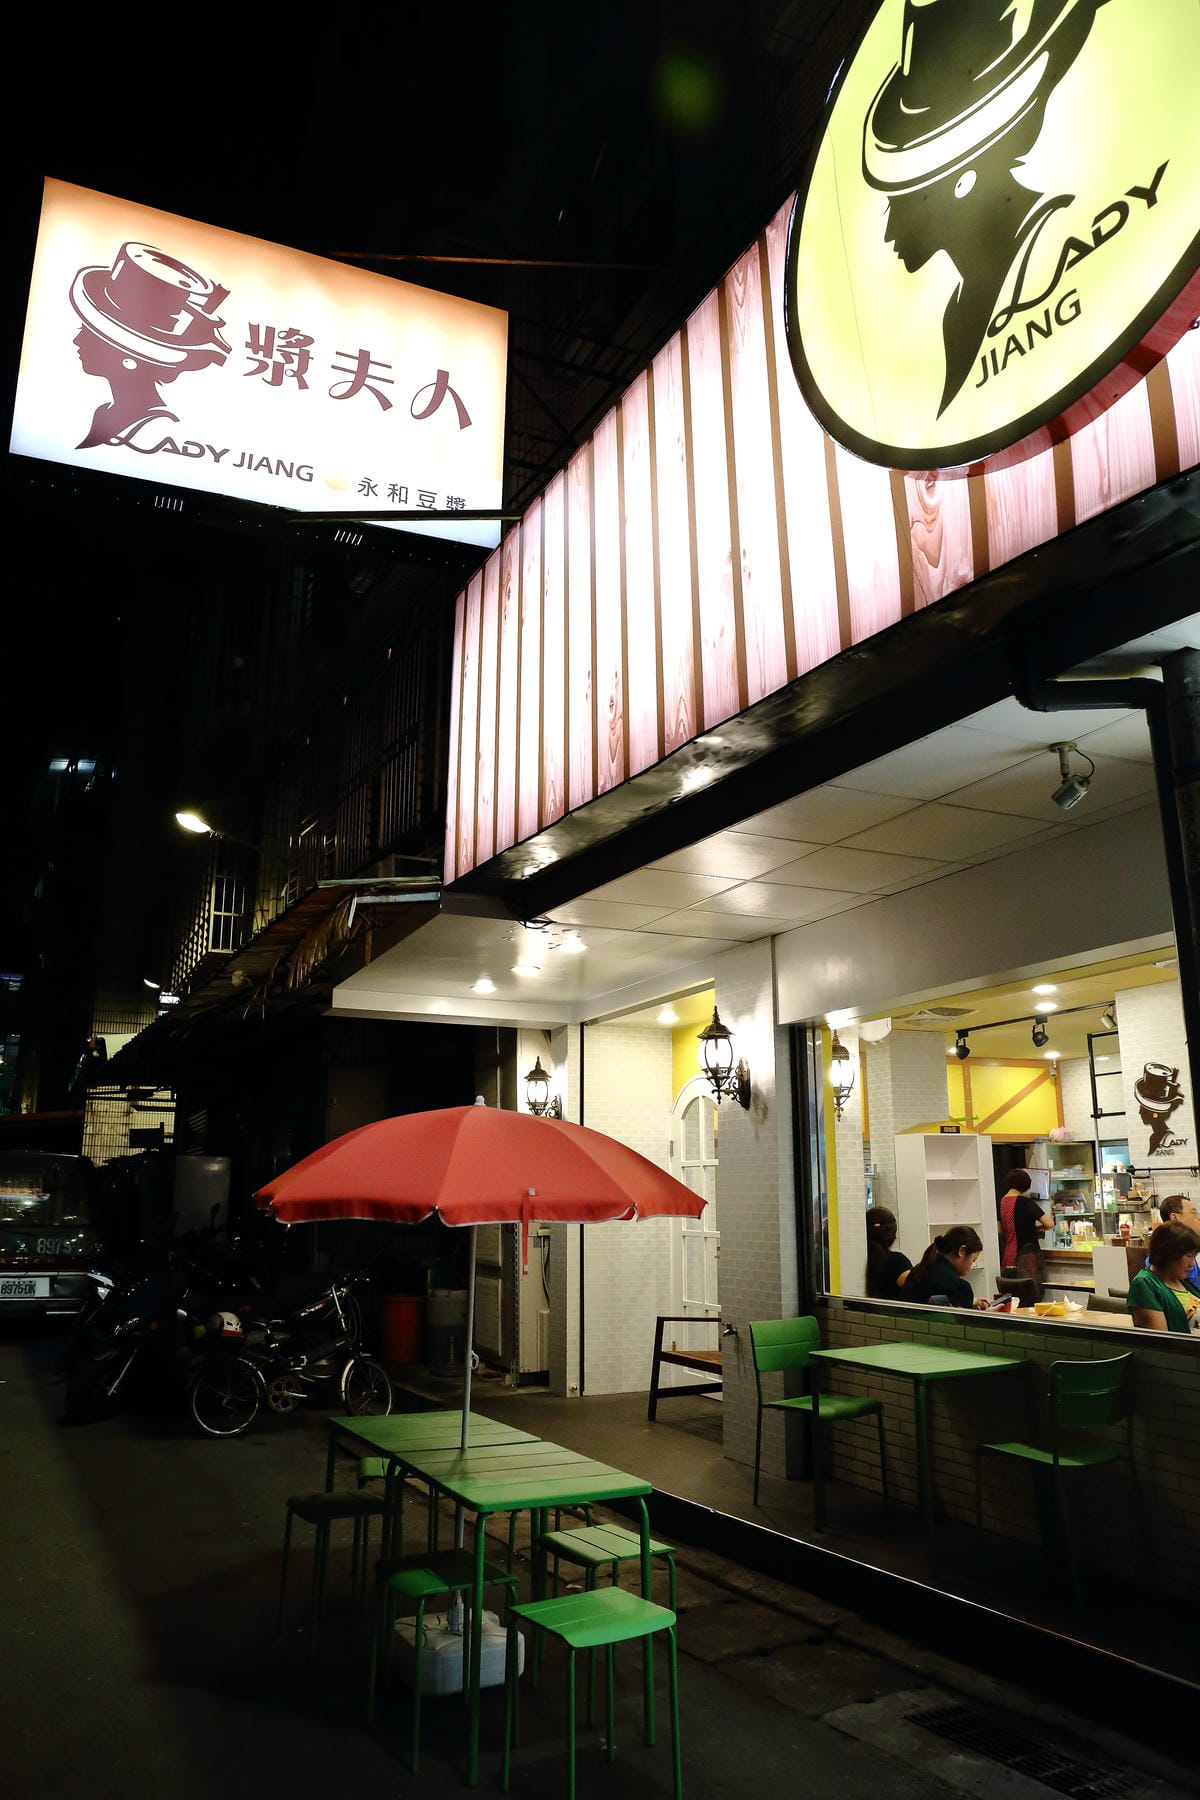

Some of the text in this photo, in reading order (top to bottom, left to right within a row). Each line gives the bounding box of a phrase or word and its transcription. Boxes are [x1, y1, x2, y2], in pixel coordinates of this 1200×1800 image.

[987, 159, 1170, 338] LADY
[243, 322, 472, 429] 漿夫人
[975, 289, 1081, 388] JIANG
[107, 410, 315, 483] LADY JIANG
[1158, 1131, 1188, 1148] LADY
